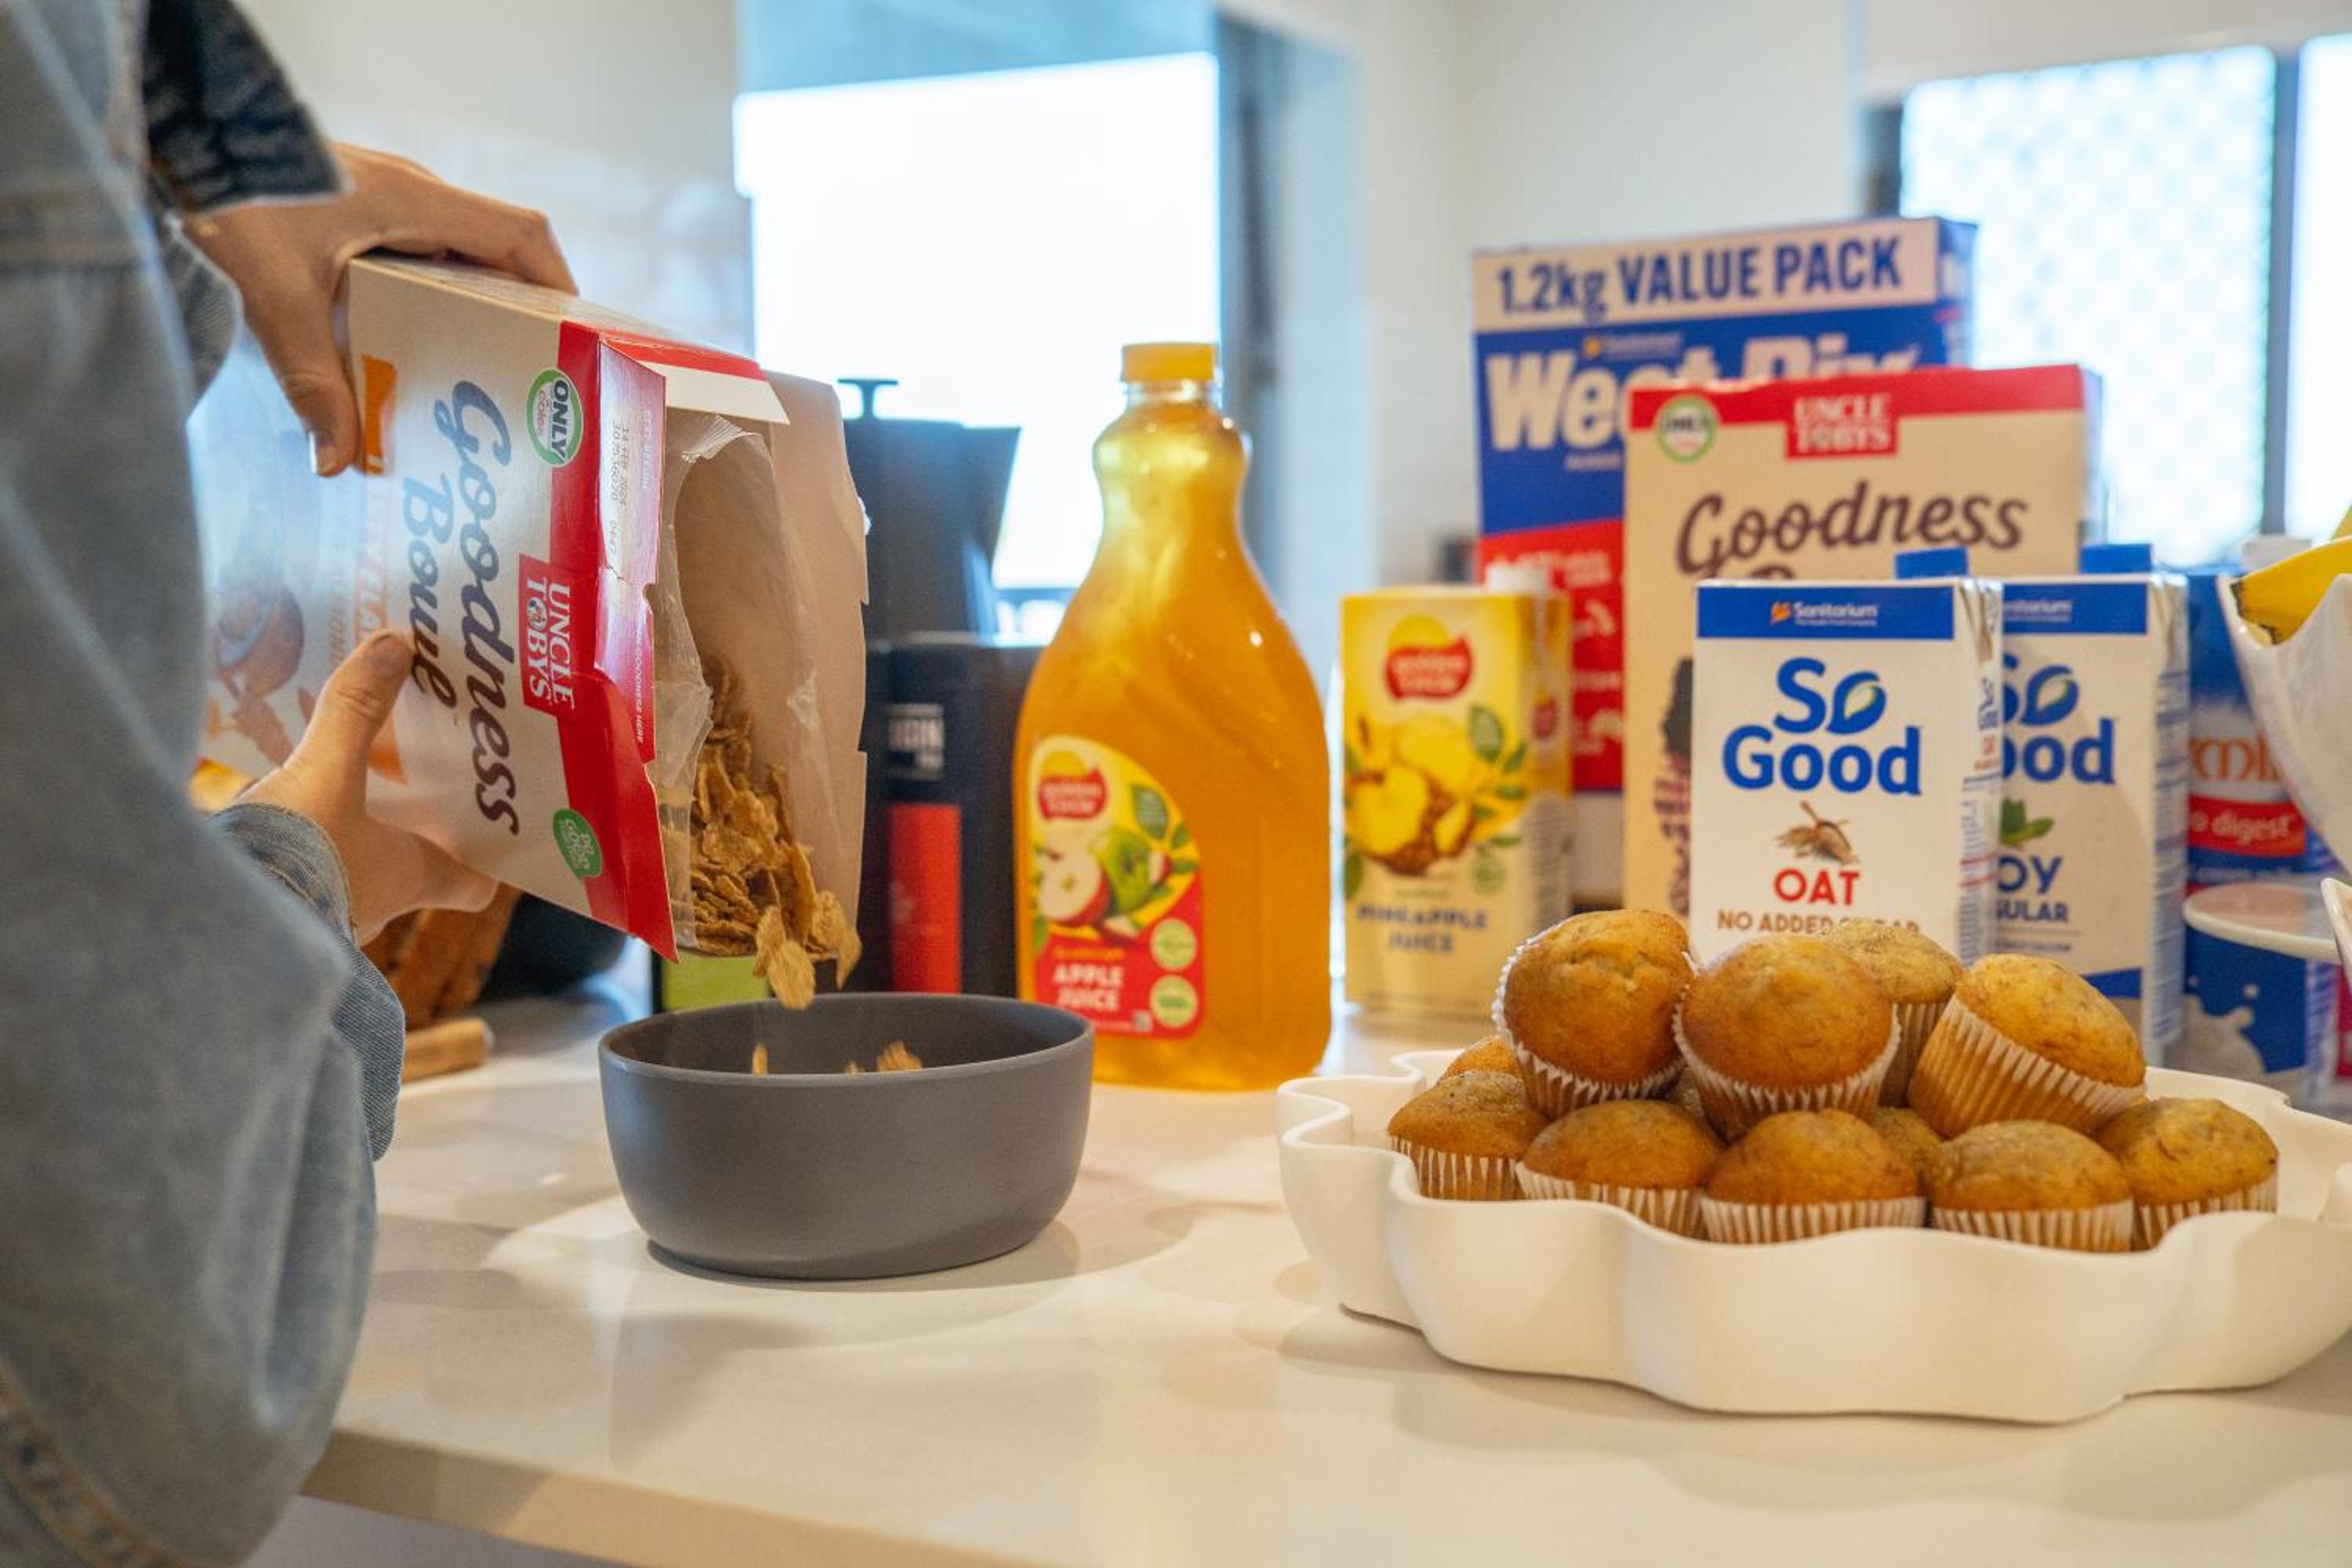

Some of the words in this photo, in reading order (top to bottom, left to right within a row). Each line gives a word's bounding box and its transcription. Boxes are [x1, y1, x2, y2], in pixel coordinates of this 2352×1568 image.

[1497, 265, 1607, 318] 1.2kg
[1618, 246, 1759, 307] VALUE
[1774, 237, 1902, 295] PACK
[551, 379, 568, 459] ONLY
[1675, 480, 2029, 579] Goodness
[434, 379, 520, 837] Goodness
[526, 576, 553, 706] TOBYS
[1792, 601, 1878, 618] Sanitarium
[549, 580, 575, 710] UNCLE
[1722, 724, 1922, 796] Good
[1773, 867, 1862, 906] OAT
[1996, 855, 2064, 895] OY
[1716, 909, 1753, 931] NO
[1053, 963, 1125, 990] APPLE
[1057, 985, 1120, 1013] JUICE
